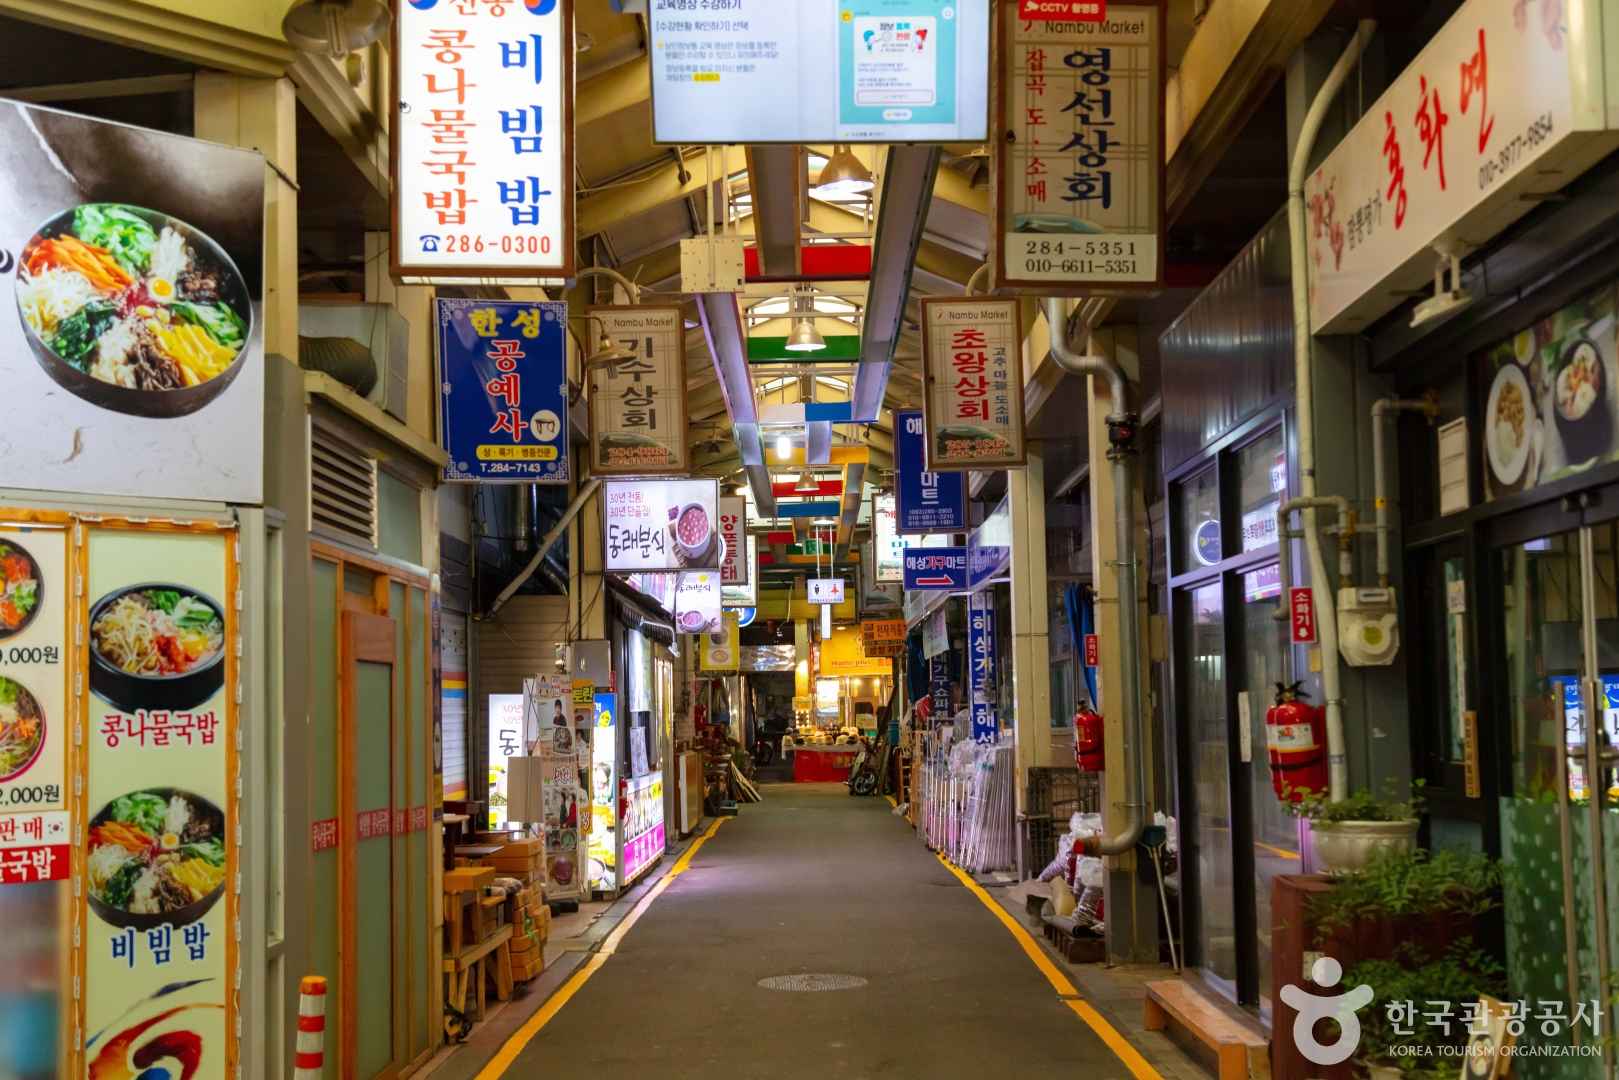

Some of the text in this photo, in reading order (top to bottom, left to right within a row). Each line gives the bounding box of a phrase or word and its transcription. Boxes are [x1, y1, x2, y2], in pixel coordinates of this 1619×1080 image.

[1040, 3, 1068, 12] CCTV
[1045, 21, 1144, 34] Nambu Market
[420, 28, 477, 226] 콩나물국밥
[496, 33, 552, 227] 비빔밥
[1058, 47, 1120, 209] 영선상회
[445, 234, 551, 254] 286-0300
[1026, 241, 1136, 256] 284-5351
[1025, 259, 1137, 274] 010-6611-5351
[467, 307, 541, 339] 한성
[614, 317, 673, 328] Nambu Market
[949, 310, 1008, 320] Nambu Market
[486, 339, 529, 443] 공예사
[952, 329, 990, 421] 초왕상회
[609, 524, 665, 559] 동래분식
[1295, 592, 1310, 626] 소화기
[100, 711, 219, 748] 콩나물국밥
[0, 847, 56, 882] 국밥
[111, 922, 210, 968] 비빔밥
